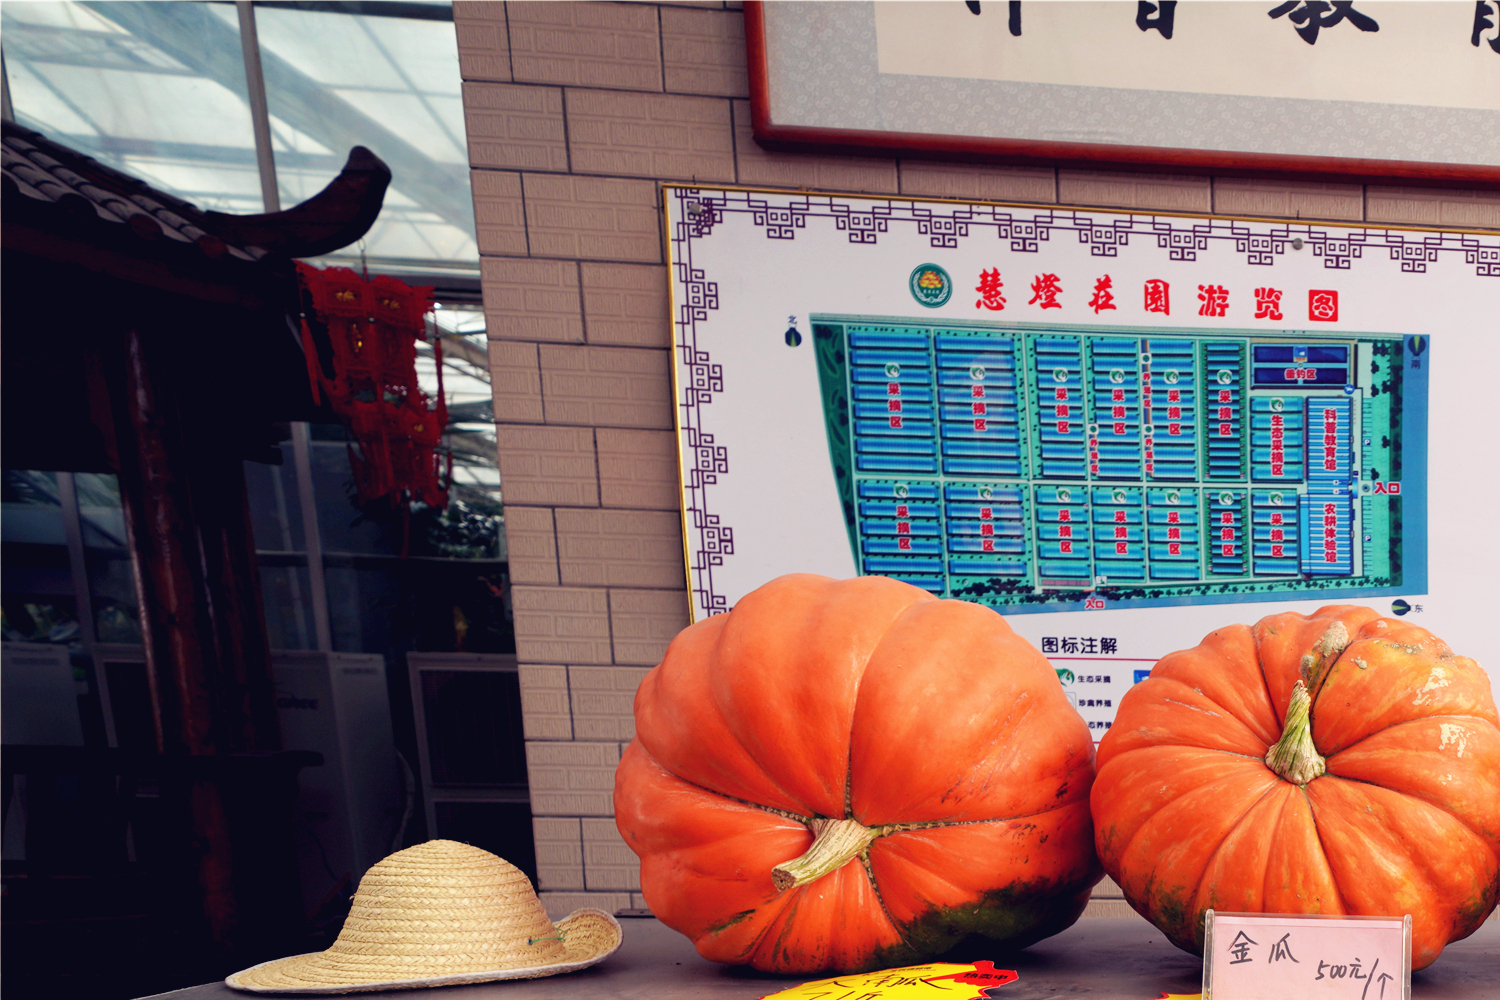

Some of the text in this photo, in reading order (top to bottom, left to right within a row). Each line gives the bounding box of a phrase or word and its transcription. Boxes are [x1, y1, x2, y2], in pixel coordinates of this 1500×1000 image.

[1284, 368, 1317, 380] 垂钓区
[887, 382, 903, 428] 采摘区
[971, 384, 987, 431] 采摘区
[1055, 387, 1070, 434] 采摘区
[1112, 388, 1127, 435] 采摘区
[1167, 389, 1181, 436] 采摘区
[1217, 390, 1232, 436] 采摘区
[1271, 414, 1284, 477] 生态采摘区
[1324, 408, 1338, 472] 科普教育馆
[1374, 482, 1401, 495] 入口
[896, 505, 911, 550] 采摘区
[979, 507, 995, 551] 采摘区
[1058, 509, 1072, 553] 采摘区
[1114, 510, 1128, 554] 采摘区
[1167, 511, 1181, 556] 采摘区
[1220, 512, 1235, 556] 采摘区
[1270, 512, 1284, 557] 采摘区
[1323, 502, 1338, 563] 农耕体验馆
[1085, 599, 1106, 610] 入口
[1042, 636, 1118, 655] 图标注解
[1077, 675, 1111, 684] 生态采摘
[1088, 721, 1112, 729] 态养殖
[1227, 930, 1300, 965] 金瓜
